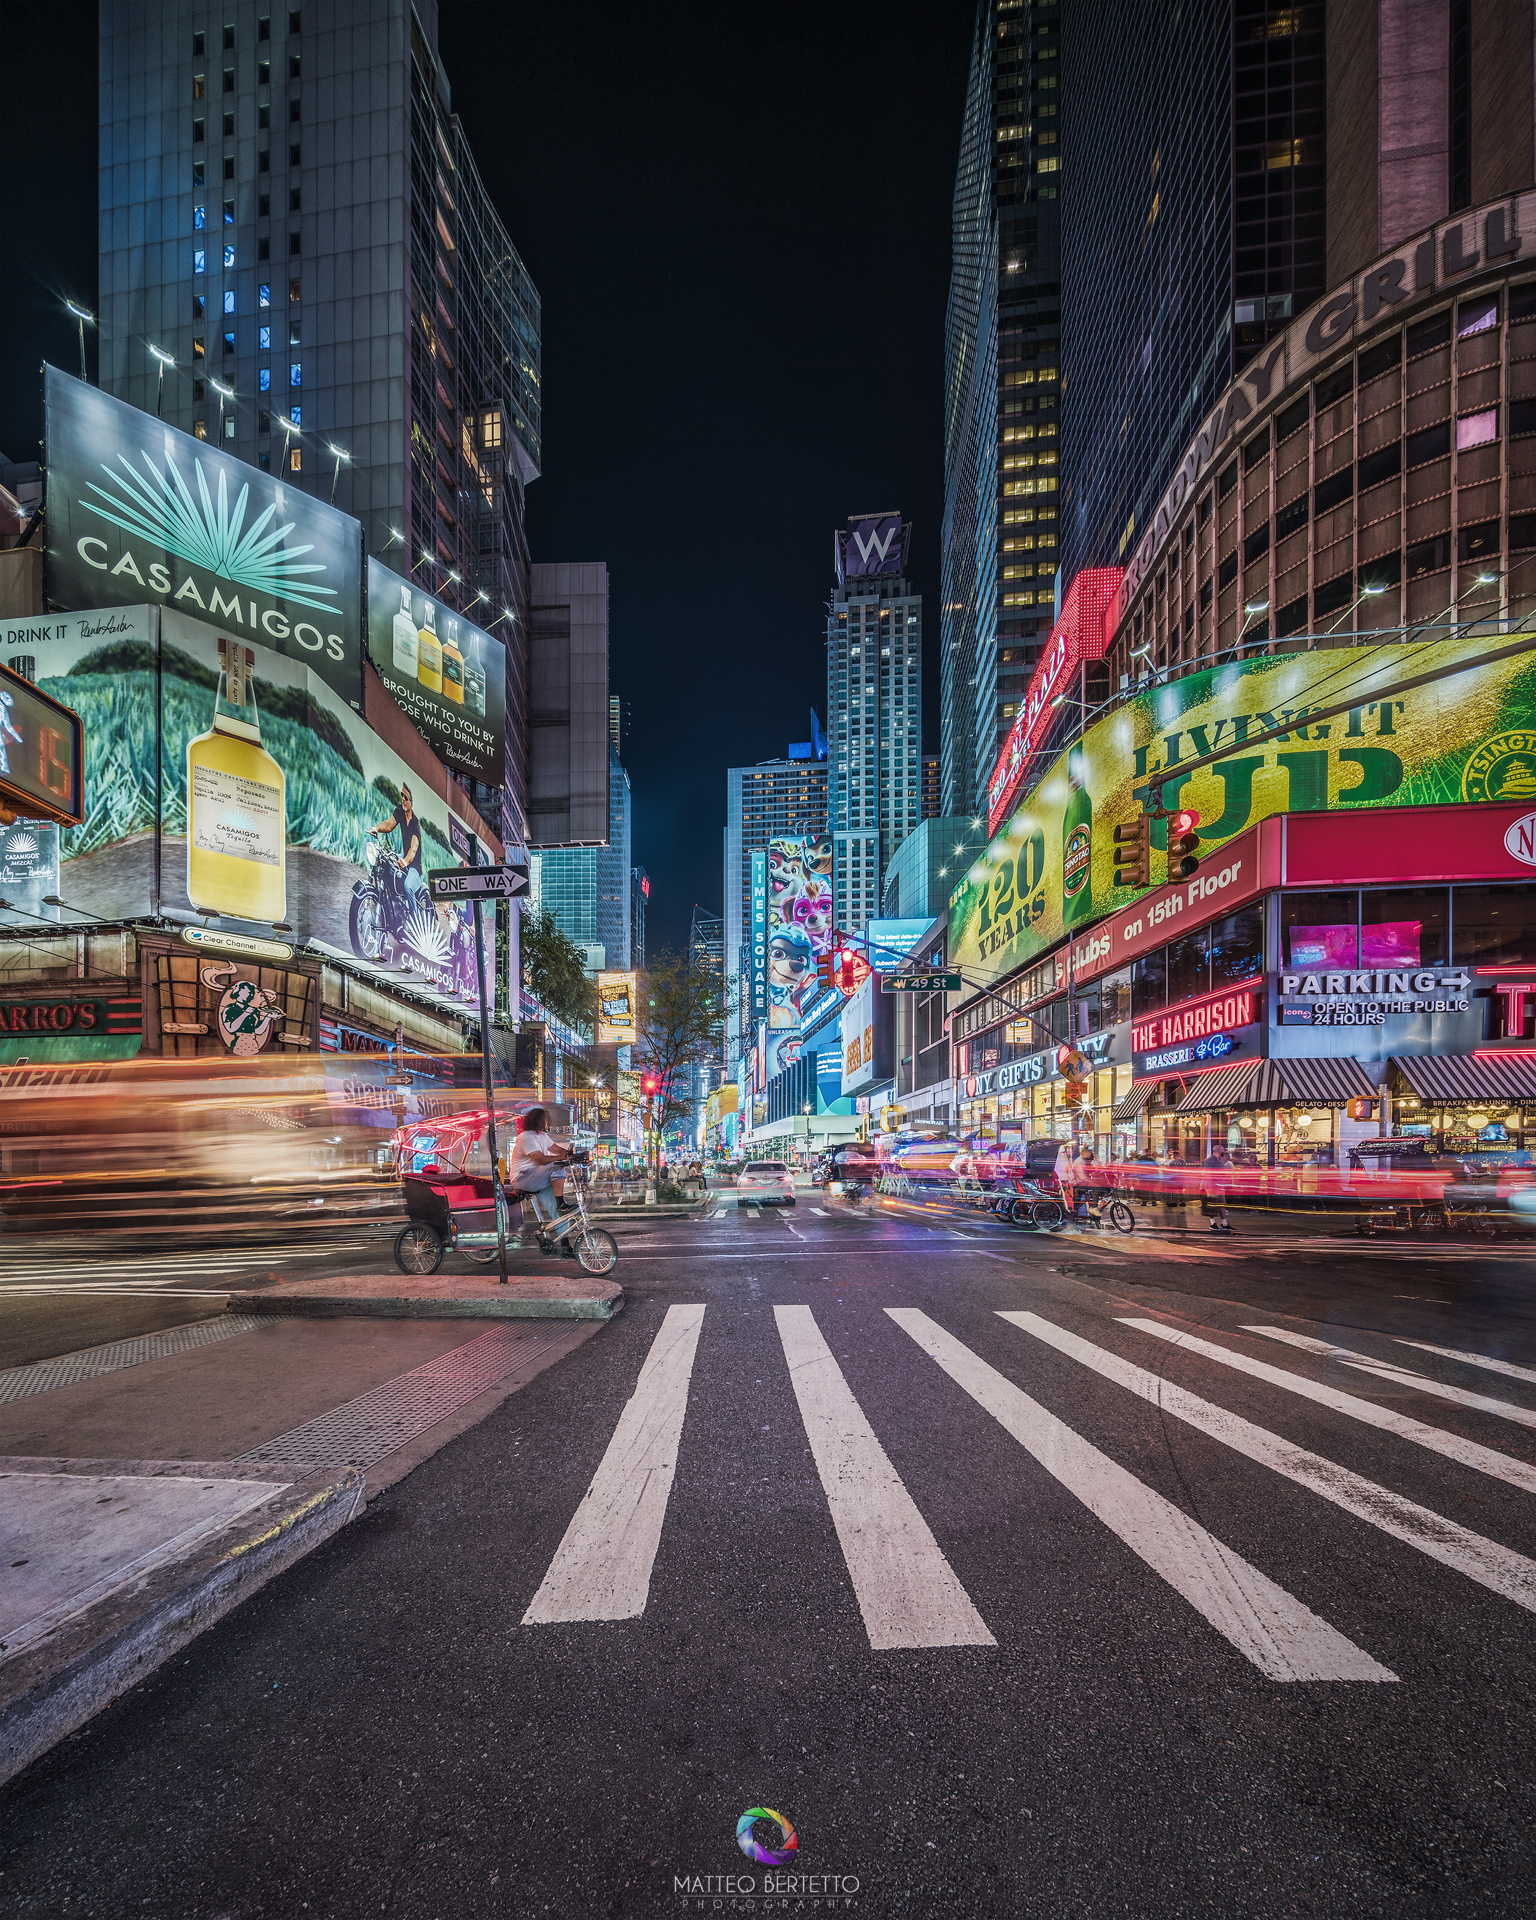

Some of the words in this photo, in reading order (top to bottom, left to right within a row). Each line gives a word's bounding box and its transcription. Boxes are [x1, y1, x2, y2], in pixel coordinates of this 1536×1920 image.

[1118, 342, 1287, 612] BROADWAY
[1306, 206, 1522, 354] GRILL
[852, 527, 896, 564] W
[76, 536, 346, 662] CASAMIGOS
[8, 626, 51, 644] DRINK
[56, 625, 67, 639] IT
[1028, 634, 1066, 726] PLAZA
[383, 677, 439, 714] BROUGHT
[441, 707, 456, 723] TO
[458, 717, 480, 737] YOU
[482, 730, 495, 744] BY
[423, 712, 451, 734] WHO
[454, 728, 485, 753] DRINK
[487, 745, 495, 757] IT
[1132, 705, 1331, 780] LIVING
[1345, 701, 1405, 738] IT
[1468, 735, 1536, 781] TSINGT
[236, 786, 266, 799] Reposado
[1132, 747, 1404, 852] UP
[216, 823, 260, 840] CASAMIGOS
[226, 832, 251, 844] Tequila
[454, 829, 468, 852] ONE
[1064, 847, 1090, 872] TSINGTAO
[438, 878, 468, 892] ONE
[484, 874, 516, 889] WAY
[754, 860, 765, 923] TIMES
[979, 827, 1045, 937] 120
[979, 888, 1046, 962] YEARS
[1066, 934, 1111, 974] clubs
[1124, 919, 1143, 941] on
[1147, 893, 1183, 928] 15th
[1188, 860, 1242, 907] Floor
[203, 934, 224, 944] Clear
[226, 938, 256, 950] Channel
[257, 944, 286, 956] Outdoor
[402, 952, 454, 988] CASAMIGOS
[754, 932, 765, 1008] SQUARE
[896, 978, 907, 989] W
[910, 978, 928, 989] 49
[932, 978, 947, 989] St
[1282, 972, 1436, 995] PARKING
[1131, 1021, 1158, 1053] THE
[1162, 991, 1251, 1046] HARRISON
[1314, 1002, 1355, 1014] OPEN
[1359, 1002, 1378, 1013] TO
[1382, 1001, 1411, 1013] THE
[1414, 1000, 1469, 1012] PUBLIC
[1314, 1014, 1330, 1025] 24
[1334, 1013, 1386, 1025] HOURS
[1145, 1047, 1195, 1070] BRASSERIE
[1196, 1040, 1207, 1060] &
[1207, 1034, 1231, 1057] Bar
[999, 1055, 1042, 1089] GIFTS
[417, 1090, 454, 1117] sbarro
